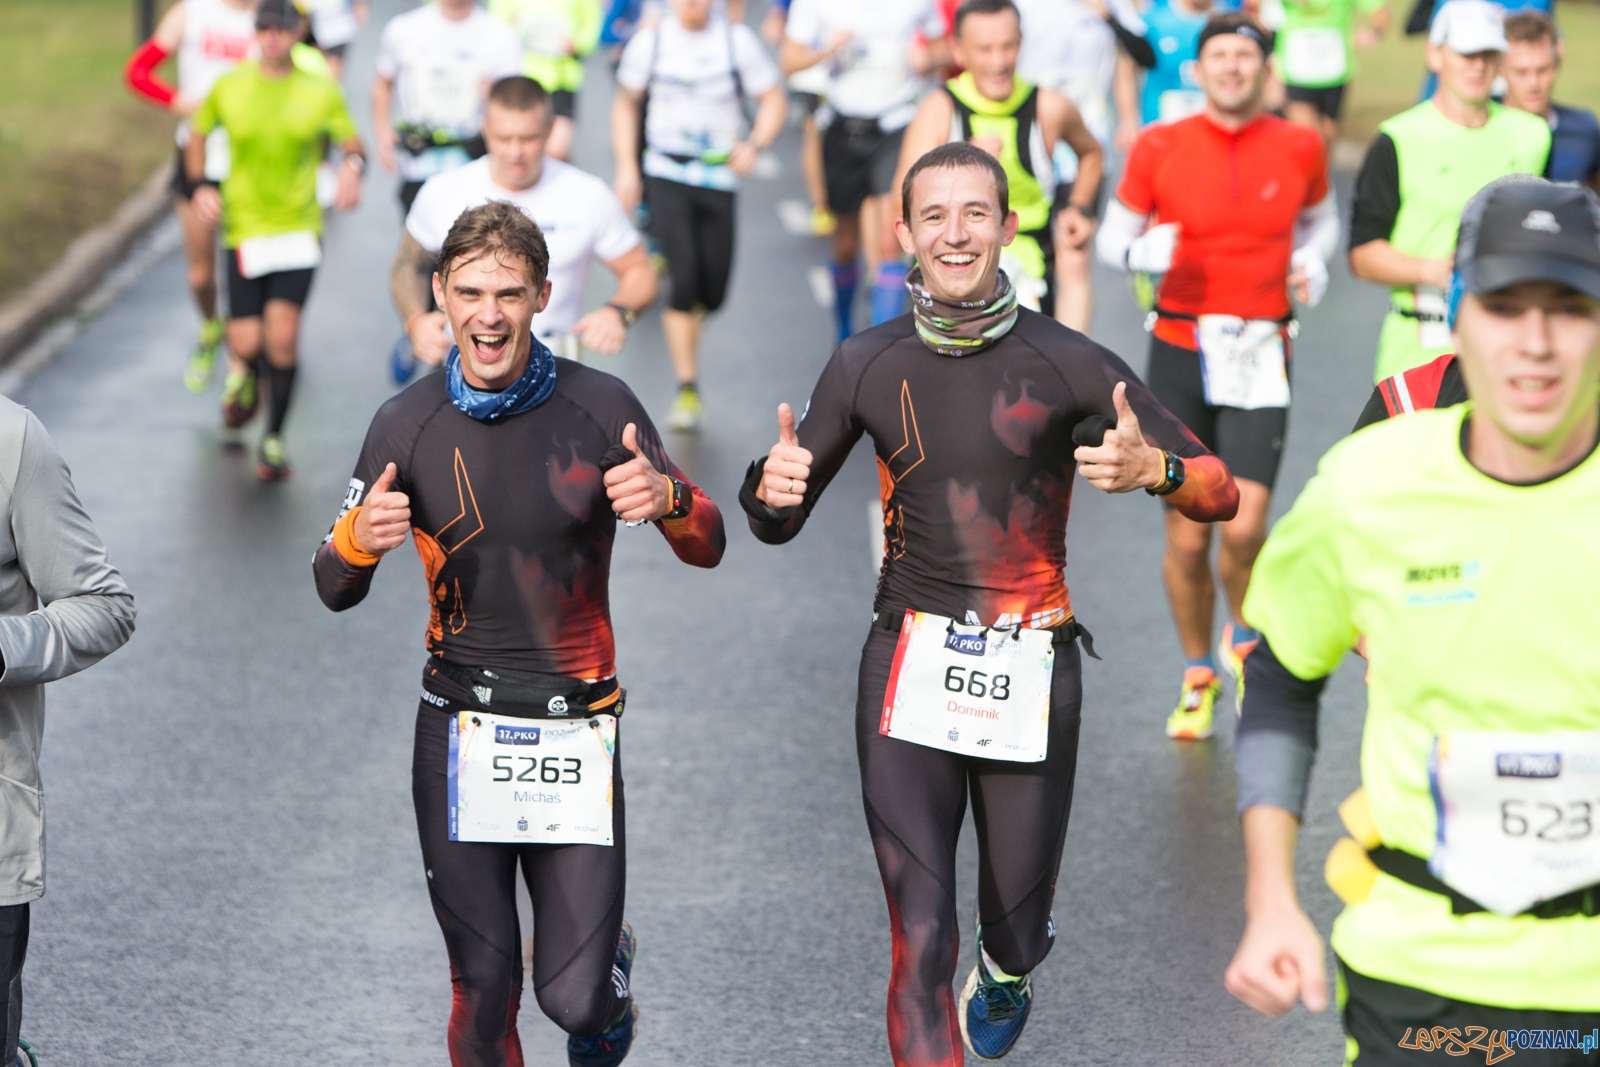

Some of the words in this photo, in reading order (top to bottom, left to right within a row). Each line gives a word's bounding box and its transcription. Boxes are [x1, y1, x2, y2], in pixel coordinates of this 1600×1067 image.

[944, 665, 1011, 701] 668
[947, 700, 1000, 719] Dominik
[976, 739, 993, 747] 4F
[493, 755, 582, 784] 5263
[514, 790, 562, 804] Michaś
[546, 823, 561, 831] 4F
[1501, 800, 1600, 842] 623
